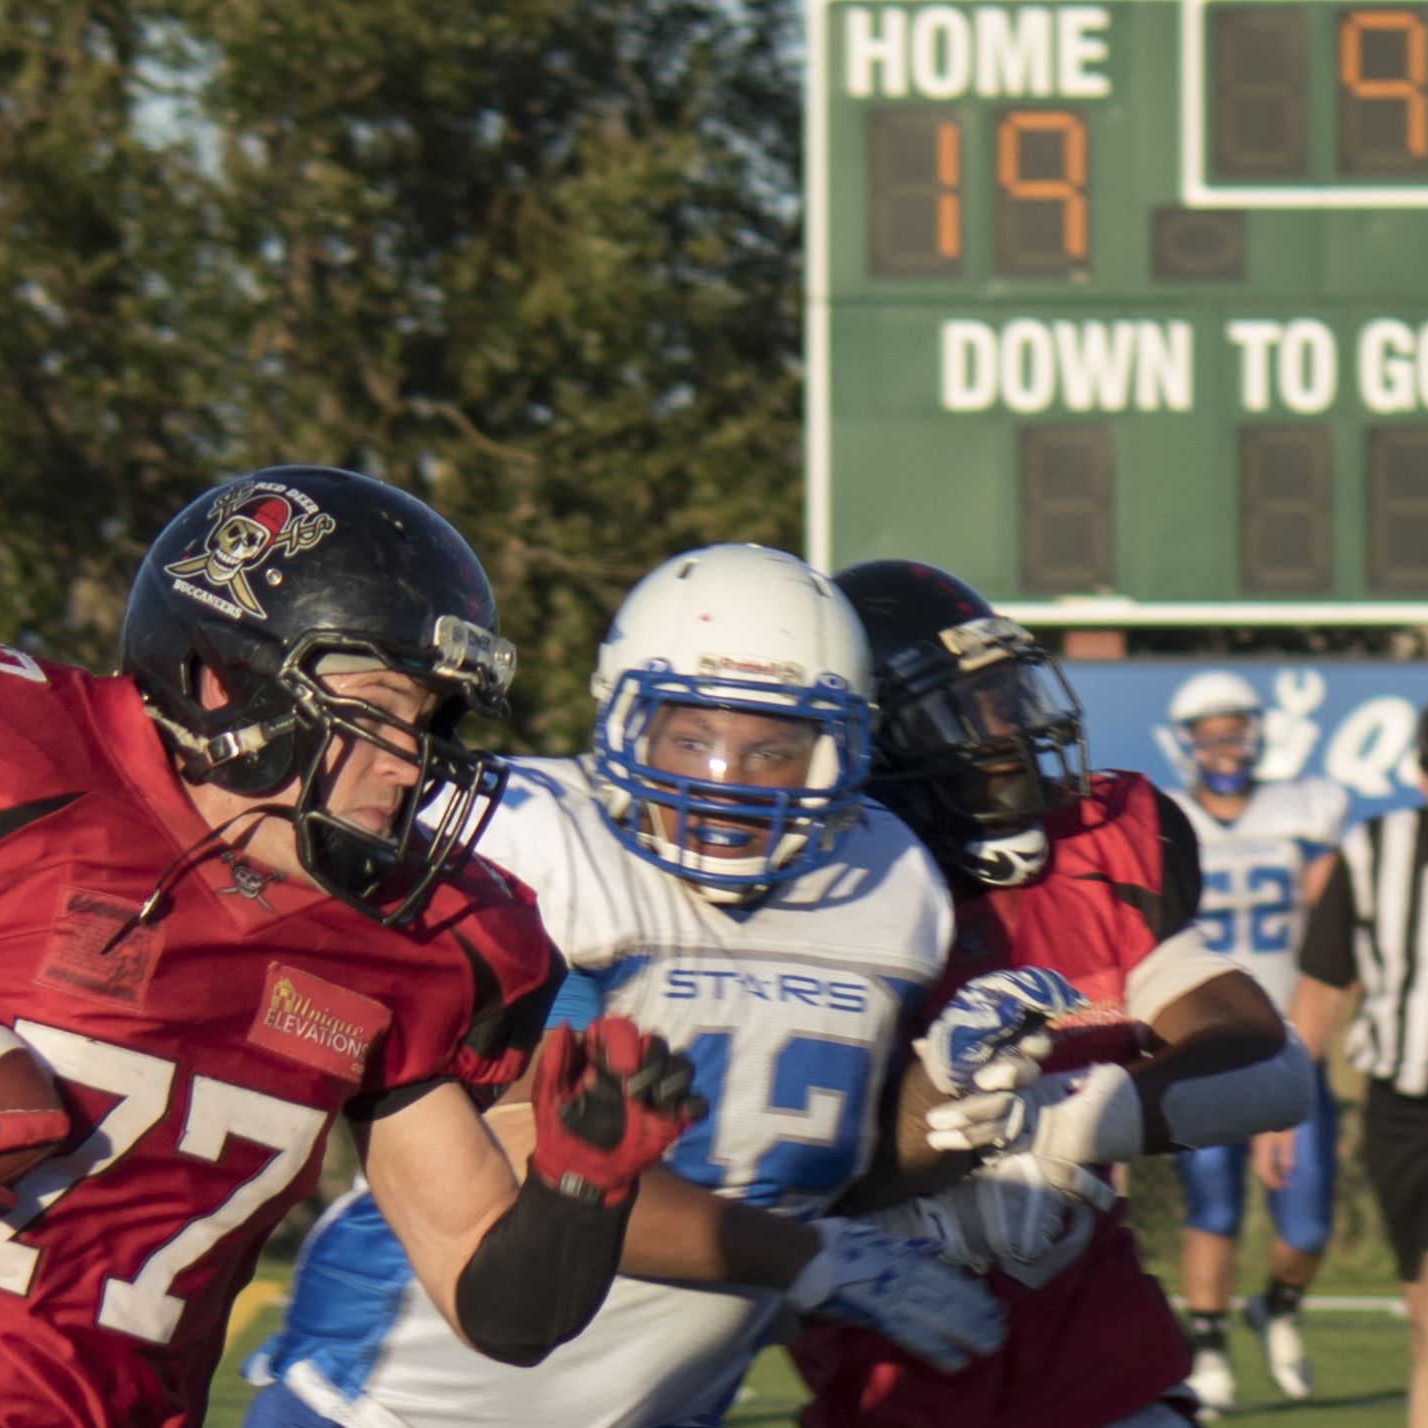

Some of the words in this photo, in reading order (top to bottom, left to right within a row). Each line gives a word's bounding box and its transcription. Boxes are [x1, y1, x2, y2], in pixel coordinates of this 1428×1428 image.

[844, 6, 1112, 99] HOME
[935, 111, 1086, 258] 19
[940, 319, 1194, 414] DOWN
[1227, 319, 1338, 414] TO
[173, 578, 243, 619] BUCCANEERS
[292, 993, 364, 1038] Unique
[663, 968, 868, 1014] STARS
